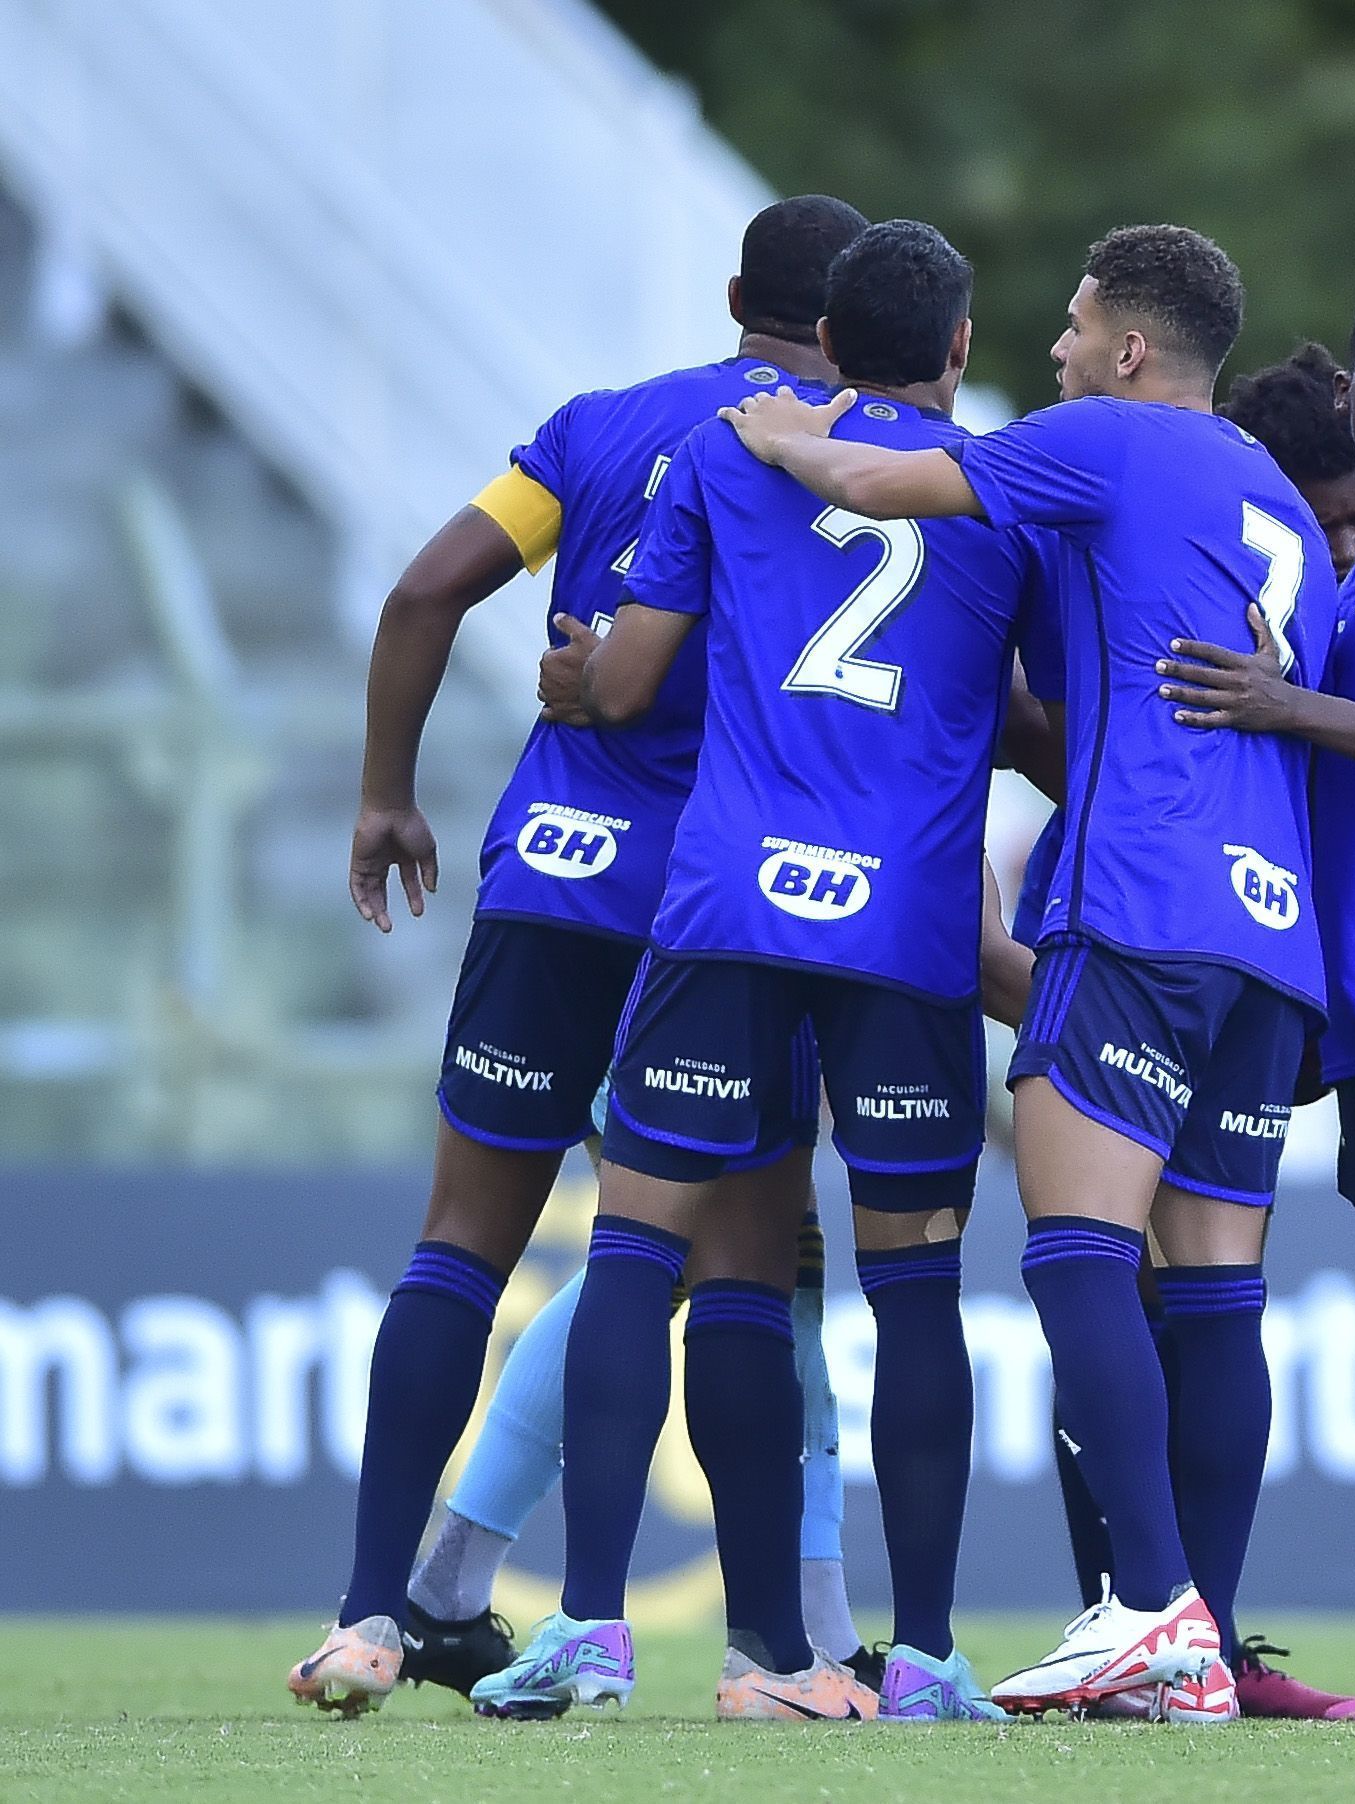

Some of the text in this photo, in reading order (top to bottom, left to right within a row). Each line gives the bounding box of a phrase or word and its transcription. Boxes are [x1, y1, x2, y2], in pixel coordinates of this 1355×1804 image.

[779, 504, 925, 711] 2
[1241, 499, 1305, 679] 7
[525, 822, 608, 866] BH
[769, 861, 859, 908] BH
[1244, 867, 1288, 917] BH
[455, 1045, 554, 1091] MULTIVIX
[645, 1067, 752, 1100] MULTIVIX
[856, 1096, 950, 1119] MULTIVIX
